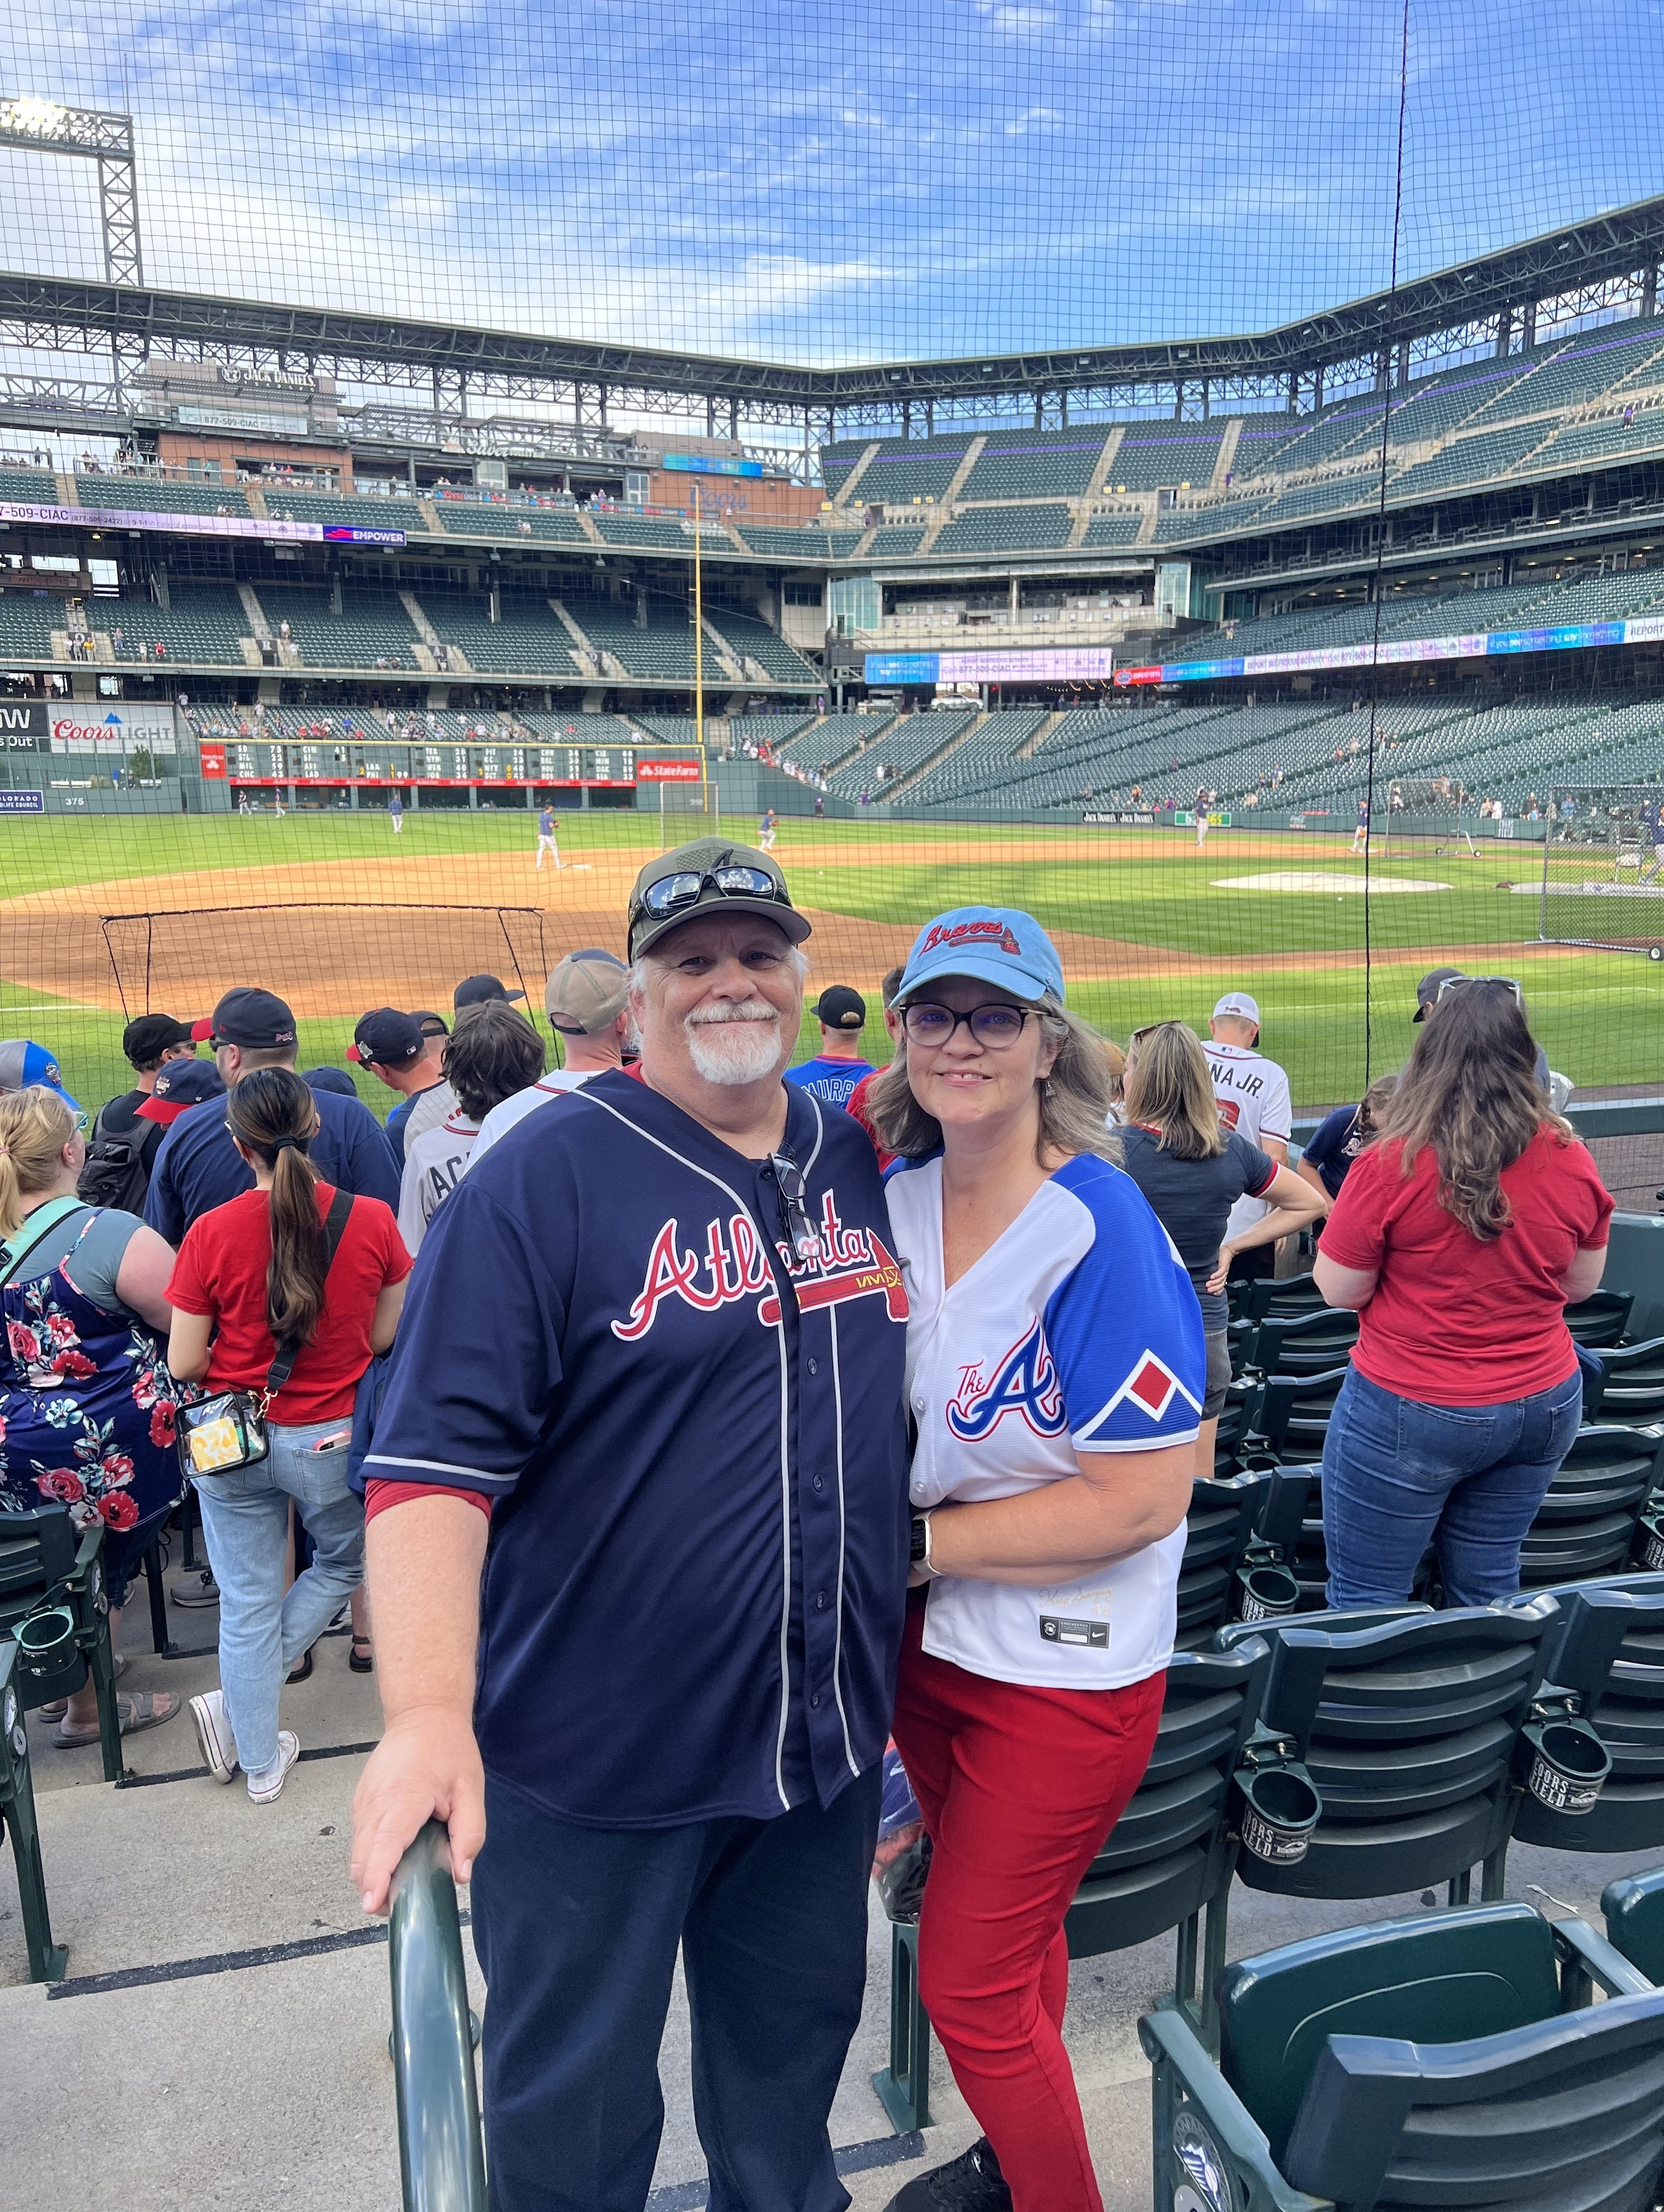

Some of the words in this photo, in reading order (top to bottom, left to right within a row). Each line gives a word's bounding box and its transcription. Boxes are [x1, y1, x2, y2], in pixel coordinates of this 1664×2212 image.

[243, 365, 272, 383] JACK
[204, 416, 259, 429] 877-509-CIAC
[353, 531, 404, 542] EMPOWER
[9, 735, 33, 747] Out
[53, 719, 116, 740] Coors
[117, 727, 171, 740] LIGHT
[396, 771, 408, 779] 99
[65, 798, 84, 806] 375
[917, 921, 1003, 959] Braves
[801, 1078, 860, 1102] MURP
[1235, 1073, 1264, 1099] JR.
[429, 1151, 471, 1200] AC
[611, 1188, 871, 1342] Atlanta
[957, 1359, 985, 1399] The
[1246, 1595, 1265, 1618] OORS
[1534, 1757, 1569, 1794] COORS
[1246, 1810, 1274, 1843] OORS
[1244, 1824, 1272, 1857] IELD
